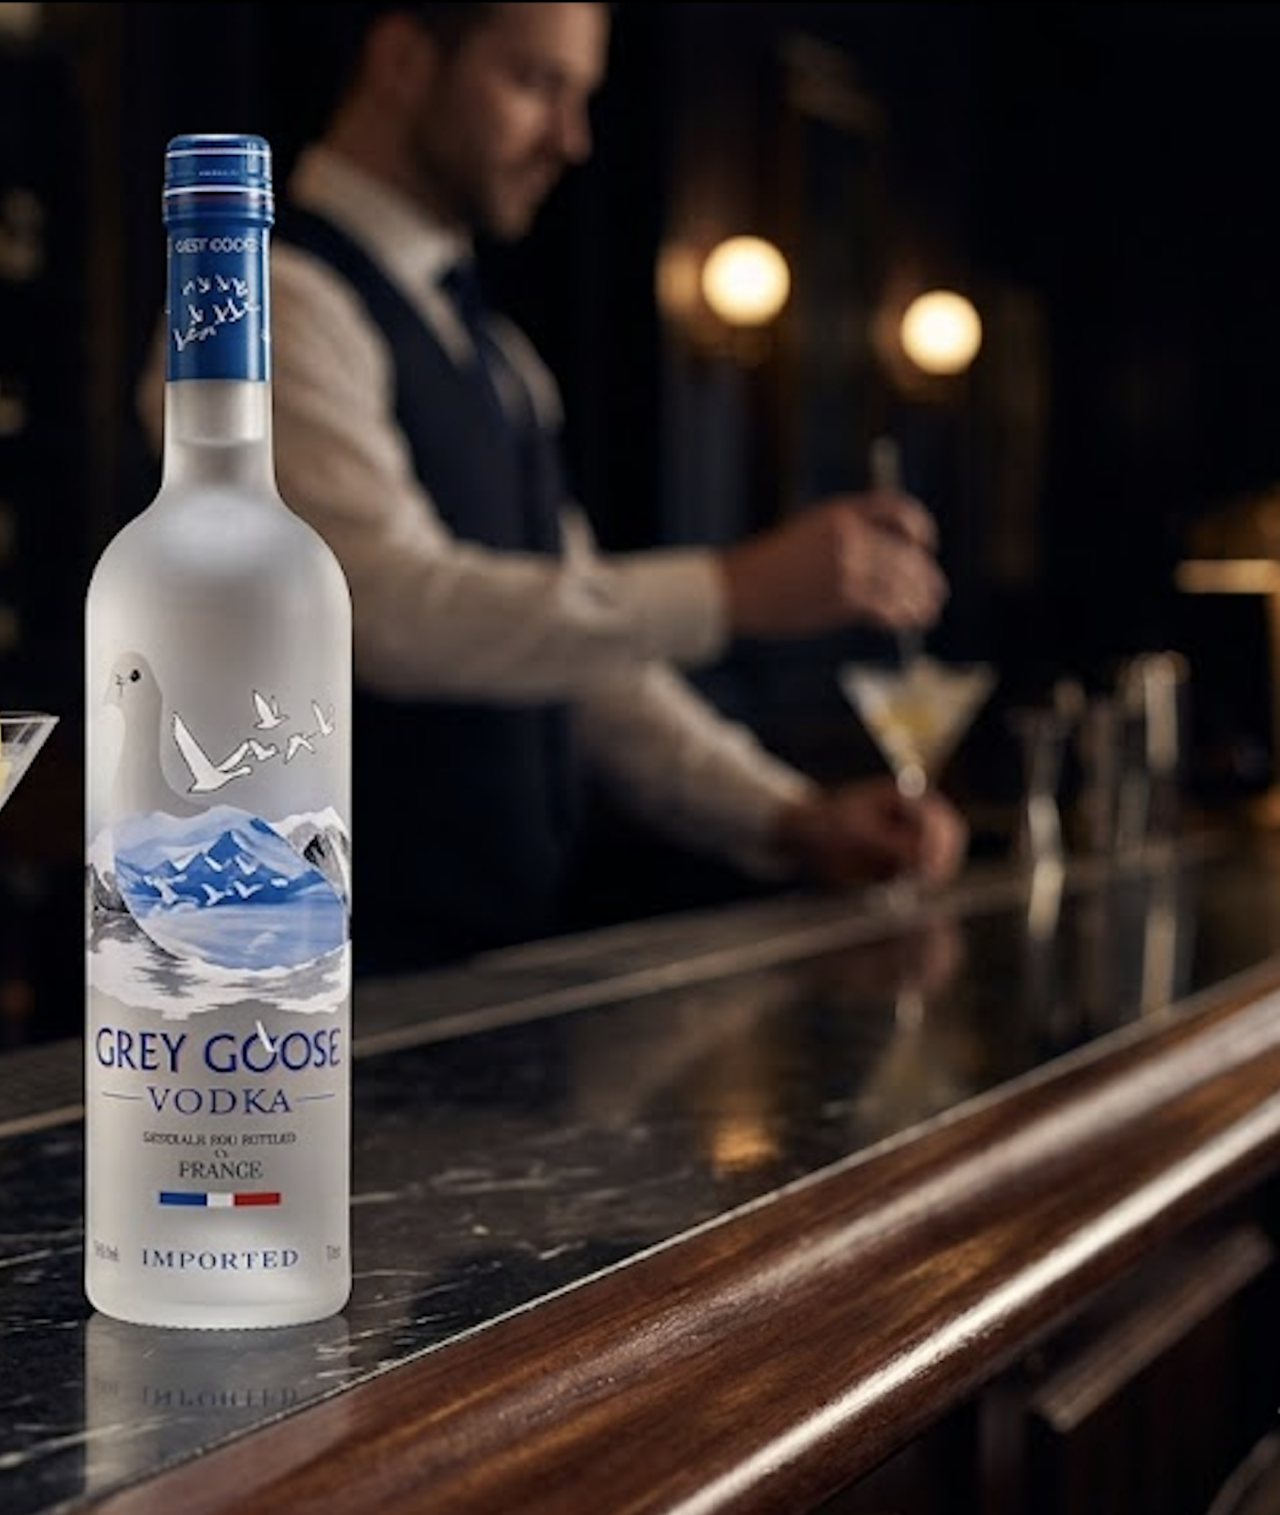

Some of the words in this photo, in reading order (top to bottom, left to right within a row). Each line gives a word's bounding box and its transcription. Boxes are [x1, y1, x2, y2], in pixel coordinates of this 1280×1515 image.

[96, 1028, 187, 1072] GREY
[204, 1029, 341, 1073] GOOSE
[148, 1087, 292, 1114] VODKA
[179, 1160, 263, 1180] FRANCE
[143, 1249, 298, 1270] IMPORTED
